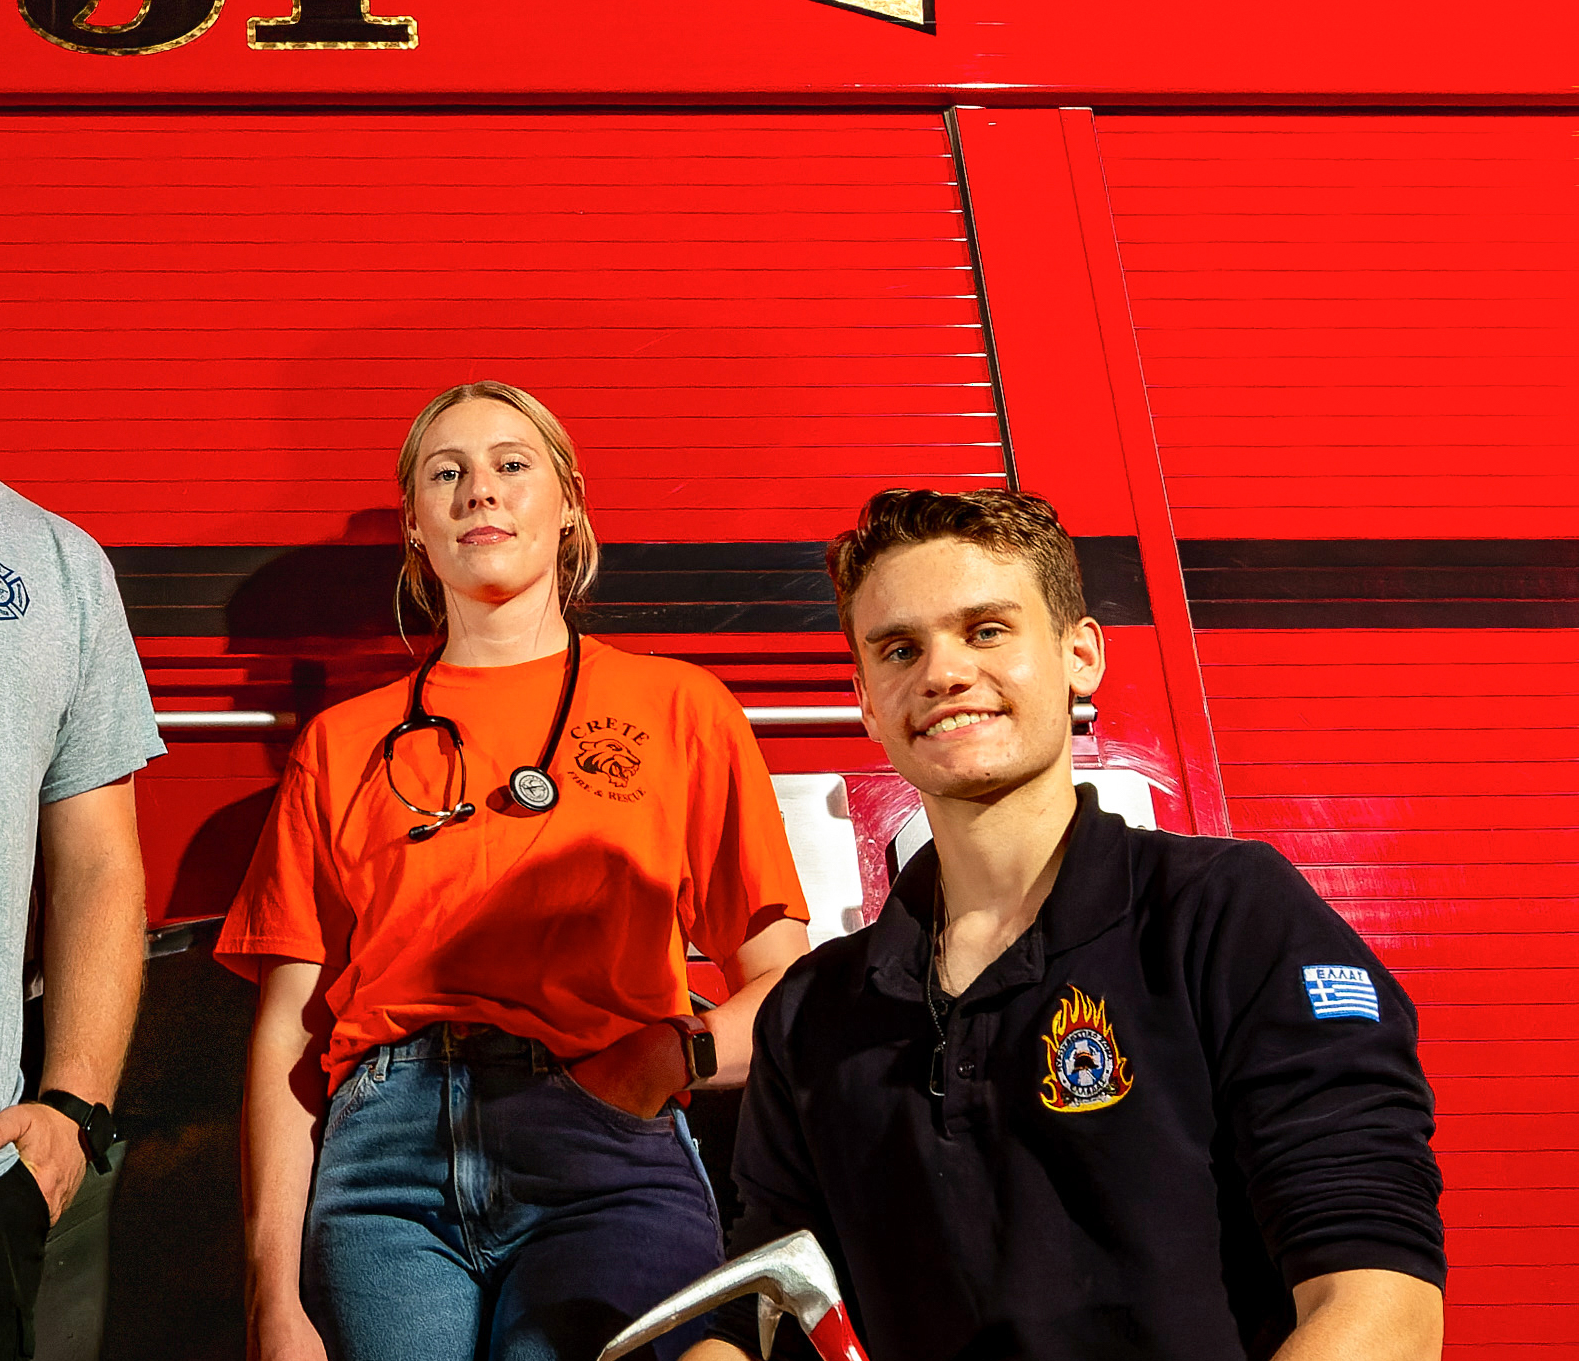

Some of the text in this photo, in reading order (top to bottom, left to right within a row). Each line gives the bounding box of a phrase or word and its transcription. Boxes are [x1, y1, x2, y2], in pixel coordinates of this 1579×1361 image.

[570, 716, 650, 747] CRETE
[594, 789, 604, 798] &
[608, 787, 647, 804] RESCUE
